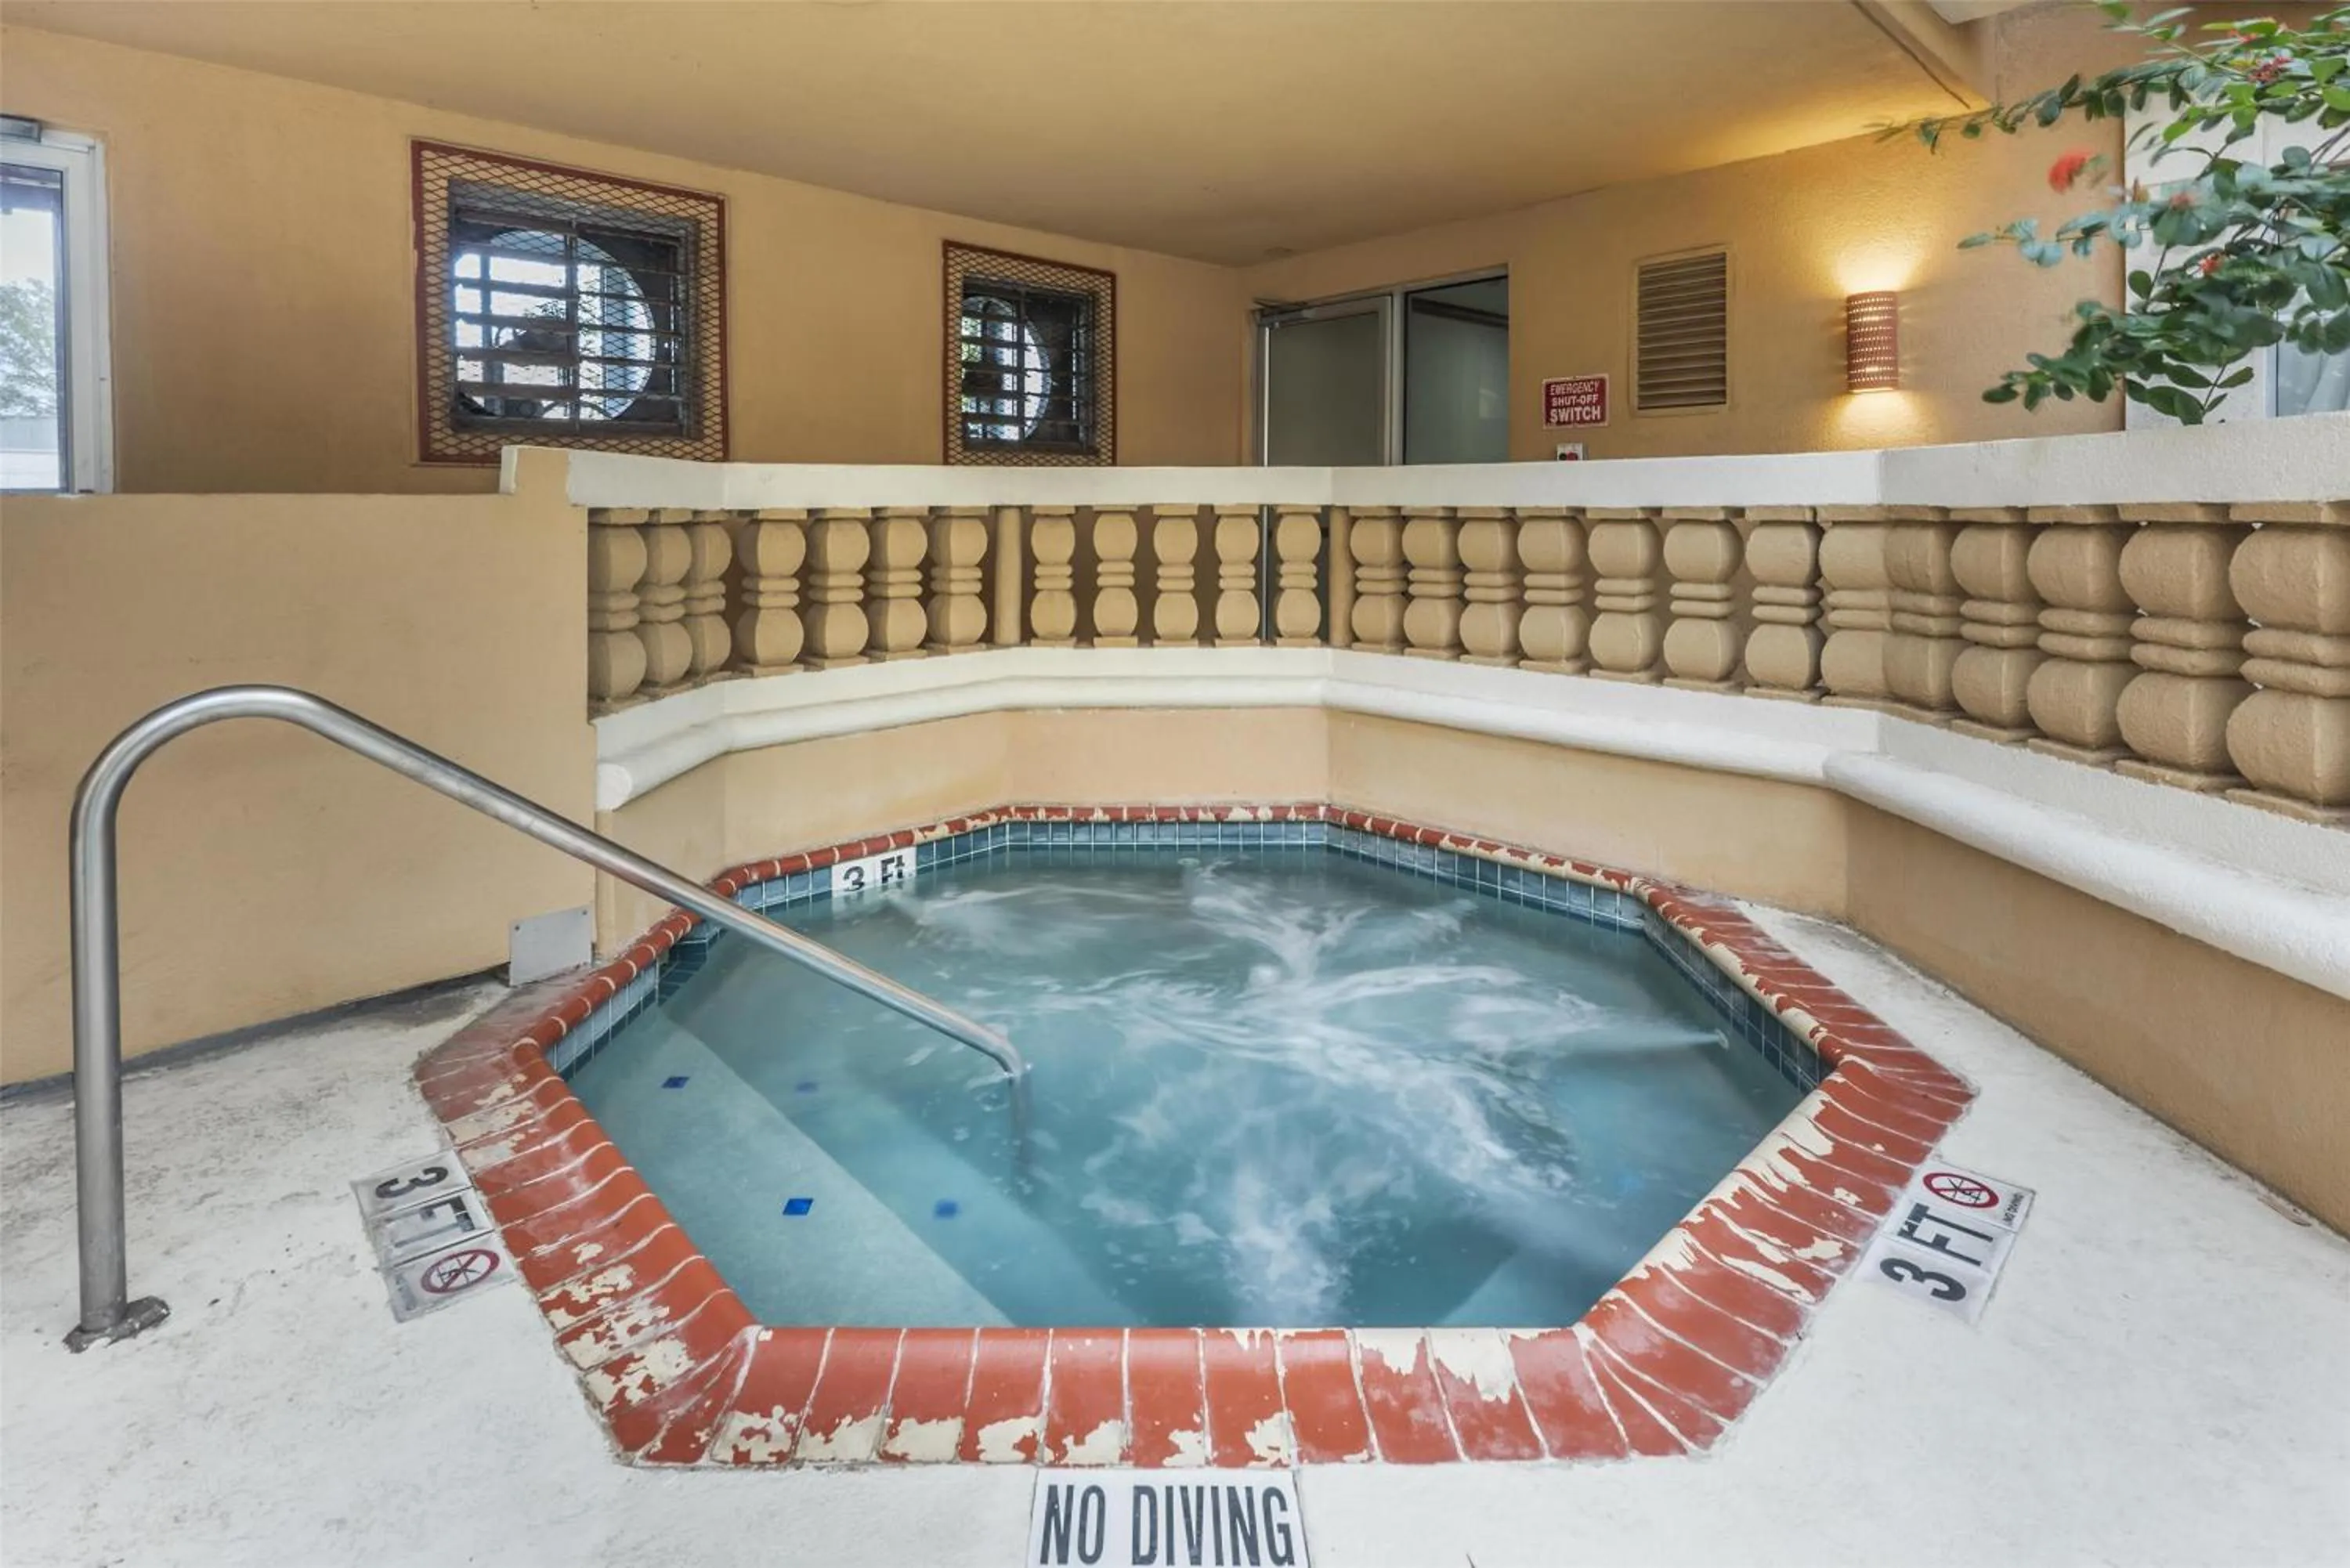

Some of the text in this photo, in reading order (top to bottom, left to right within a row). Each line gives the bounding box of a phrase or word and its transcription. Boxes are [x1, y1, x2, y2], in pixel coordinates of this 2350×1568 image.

[1550, 381, 1600, 396] EMERGENCY
[1552, 394, 1599, 406] SHUT-OFF
[1550, 406, 1601, 424] SWITCH
[844, 865, 865, 891] 3
[375, 1166, 475, 1248] 3 FT
[1880, 1202, 1994, 1302] 3 FT
[1039, 1485, 1296, 1567] NO DIVING
